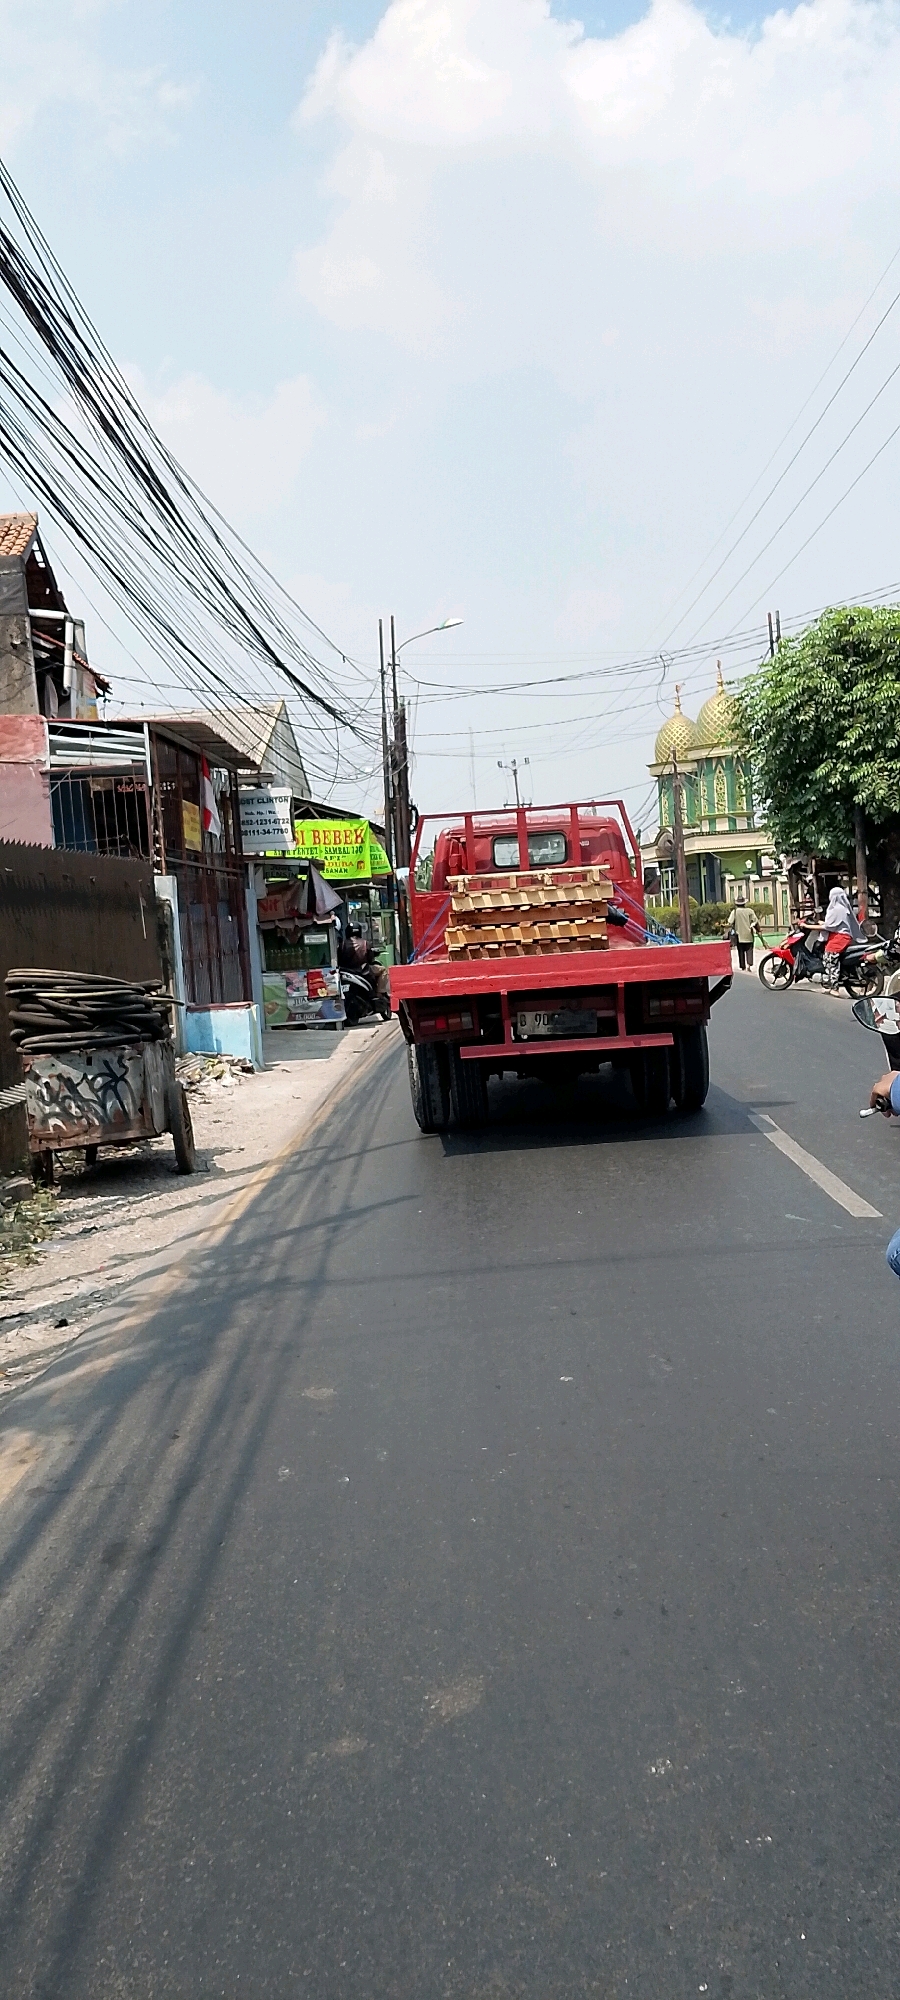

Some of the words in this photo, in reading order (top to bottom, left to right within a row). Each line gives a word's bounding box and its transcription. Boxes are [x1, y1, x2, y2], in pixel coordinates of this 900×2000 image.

[257, 796, 288, 804] CLINTON
[312, 828, 365, 845] BEBEK
[324, 845, 350, 855] SAMBAL
